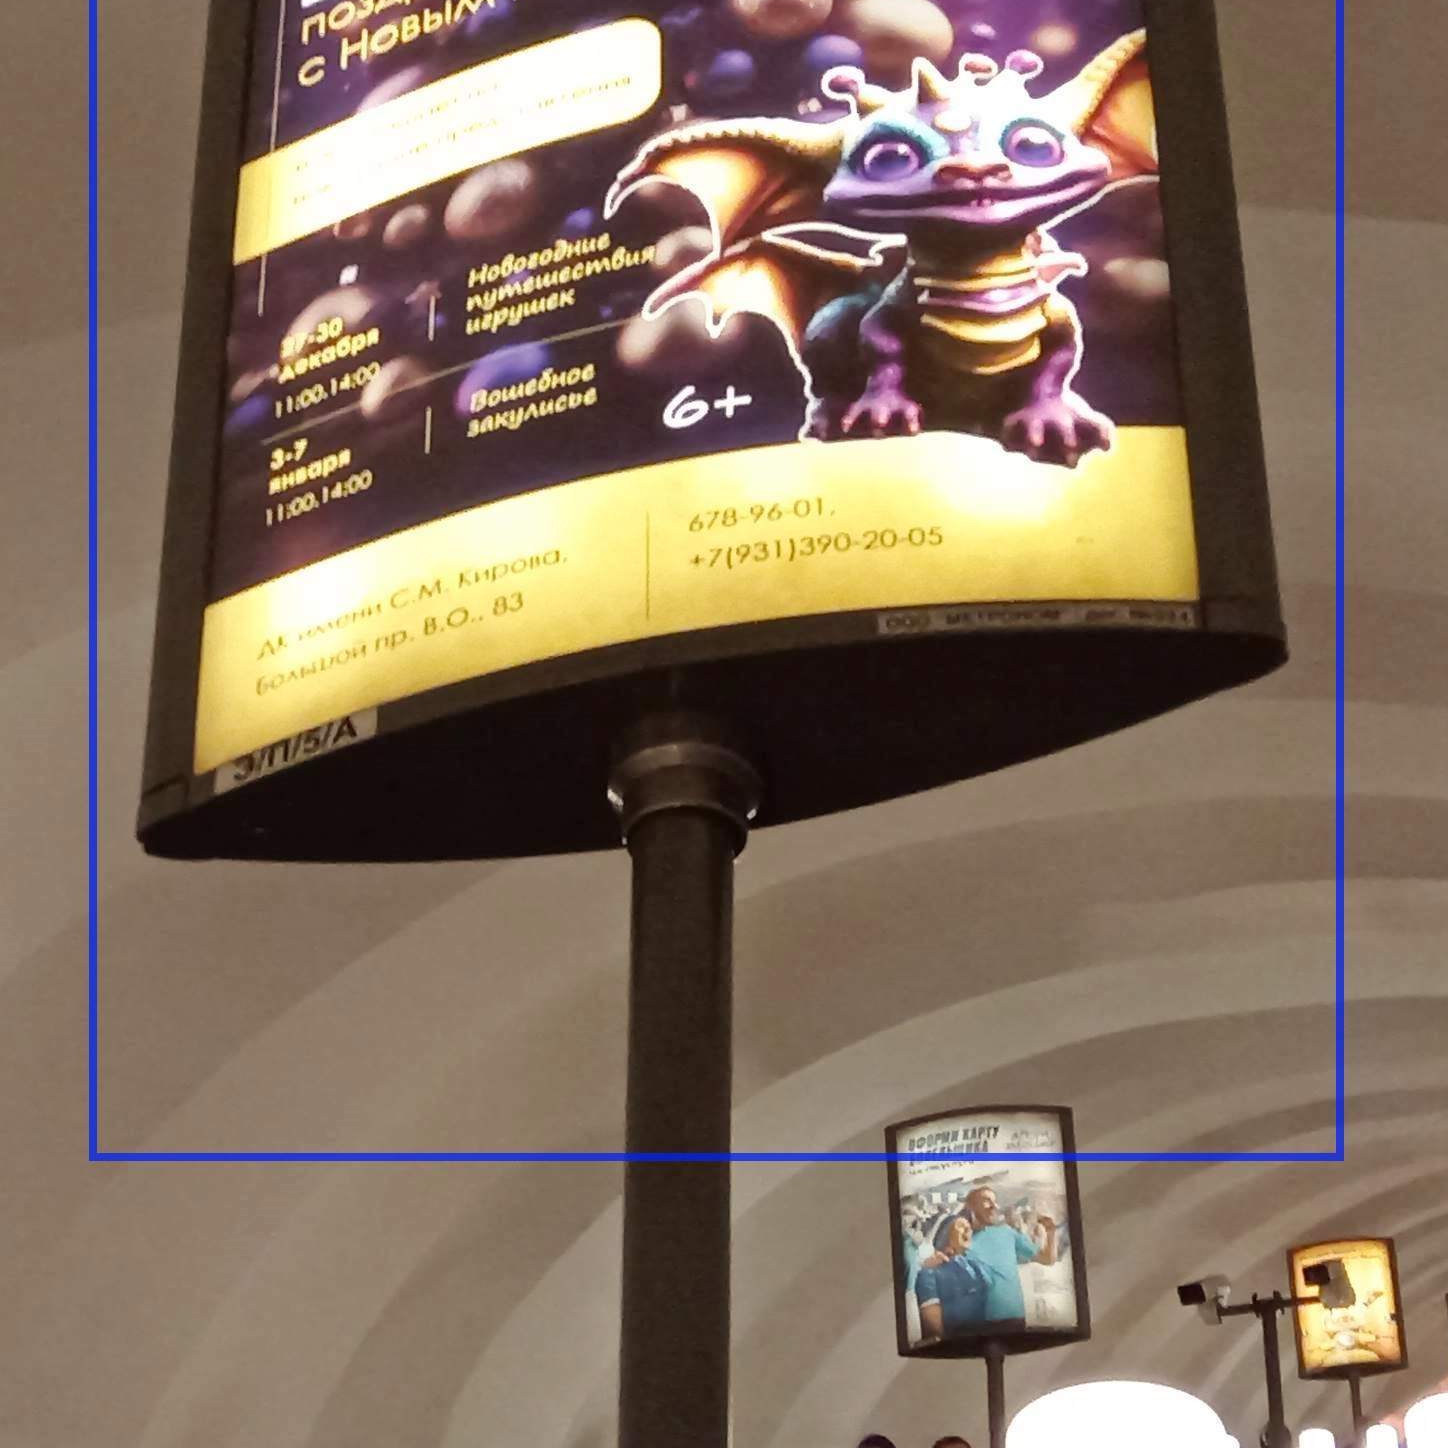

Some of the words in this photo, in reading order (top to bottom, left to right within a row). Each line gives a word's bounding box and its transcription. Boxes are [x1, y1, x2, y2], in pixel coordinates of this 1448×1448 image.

[466, 244, 657, 312] путешествия
[467, 232, 611, 289] Новогодние
[465, 287, 576, 336] игрушек
[466, 386, 598, 438] закулисье
[661, 384, 753, 430] 6+
[270, 437, 308, 470] 3-7
[689, 525, 944, 570] +7(931)390-20-05
[491, 591, 525, 618] 83
